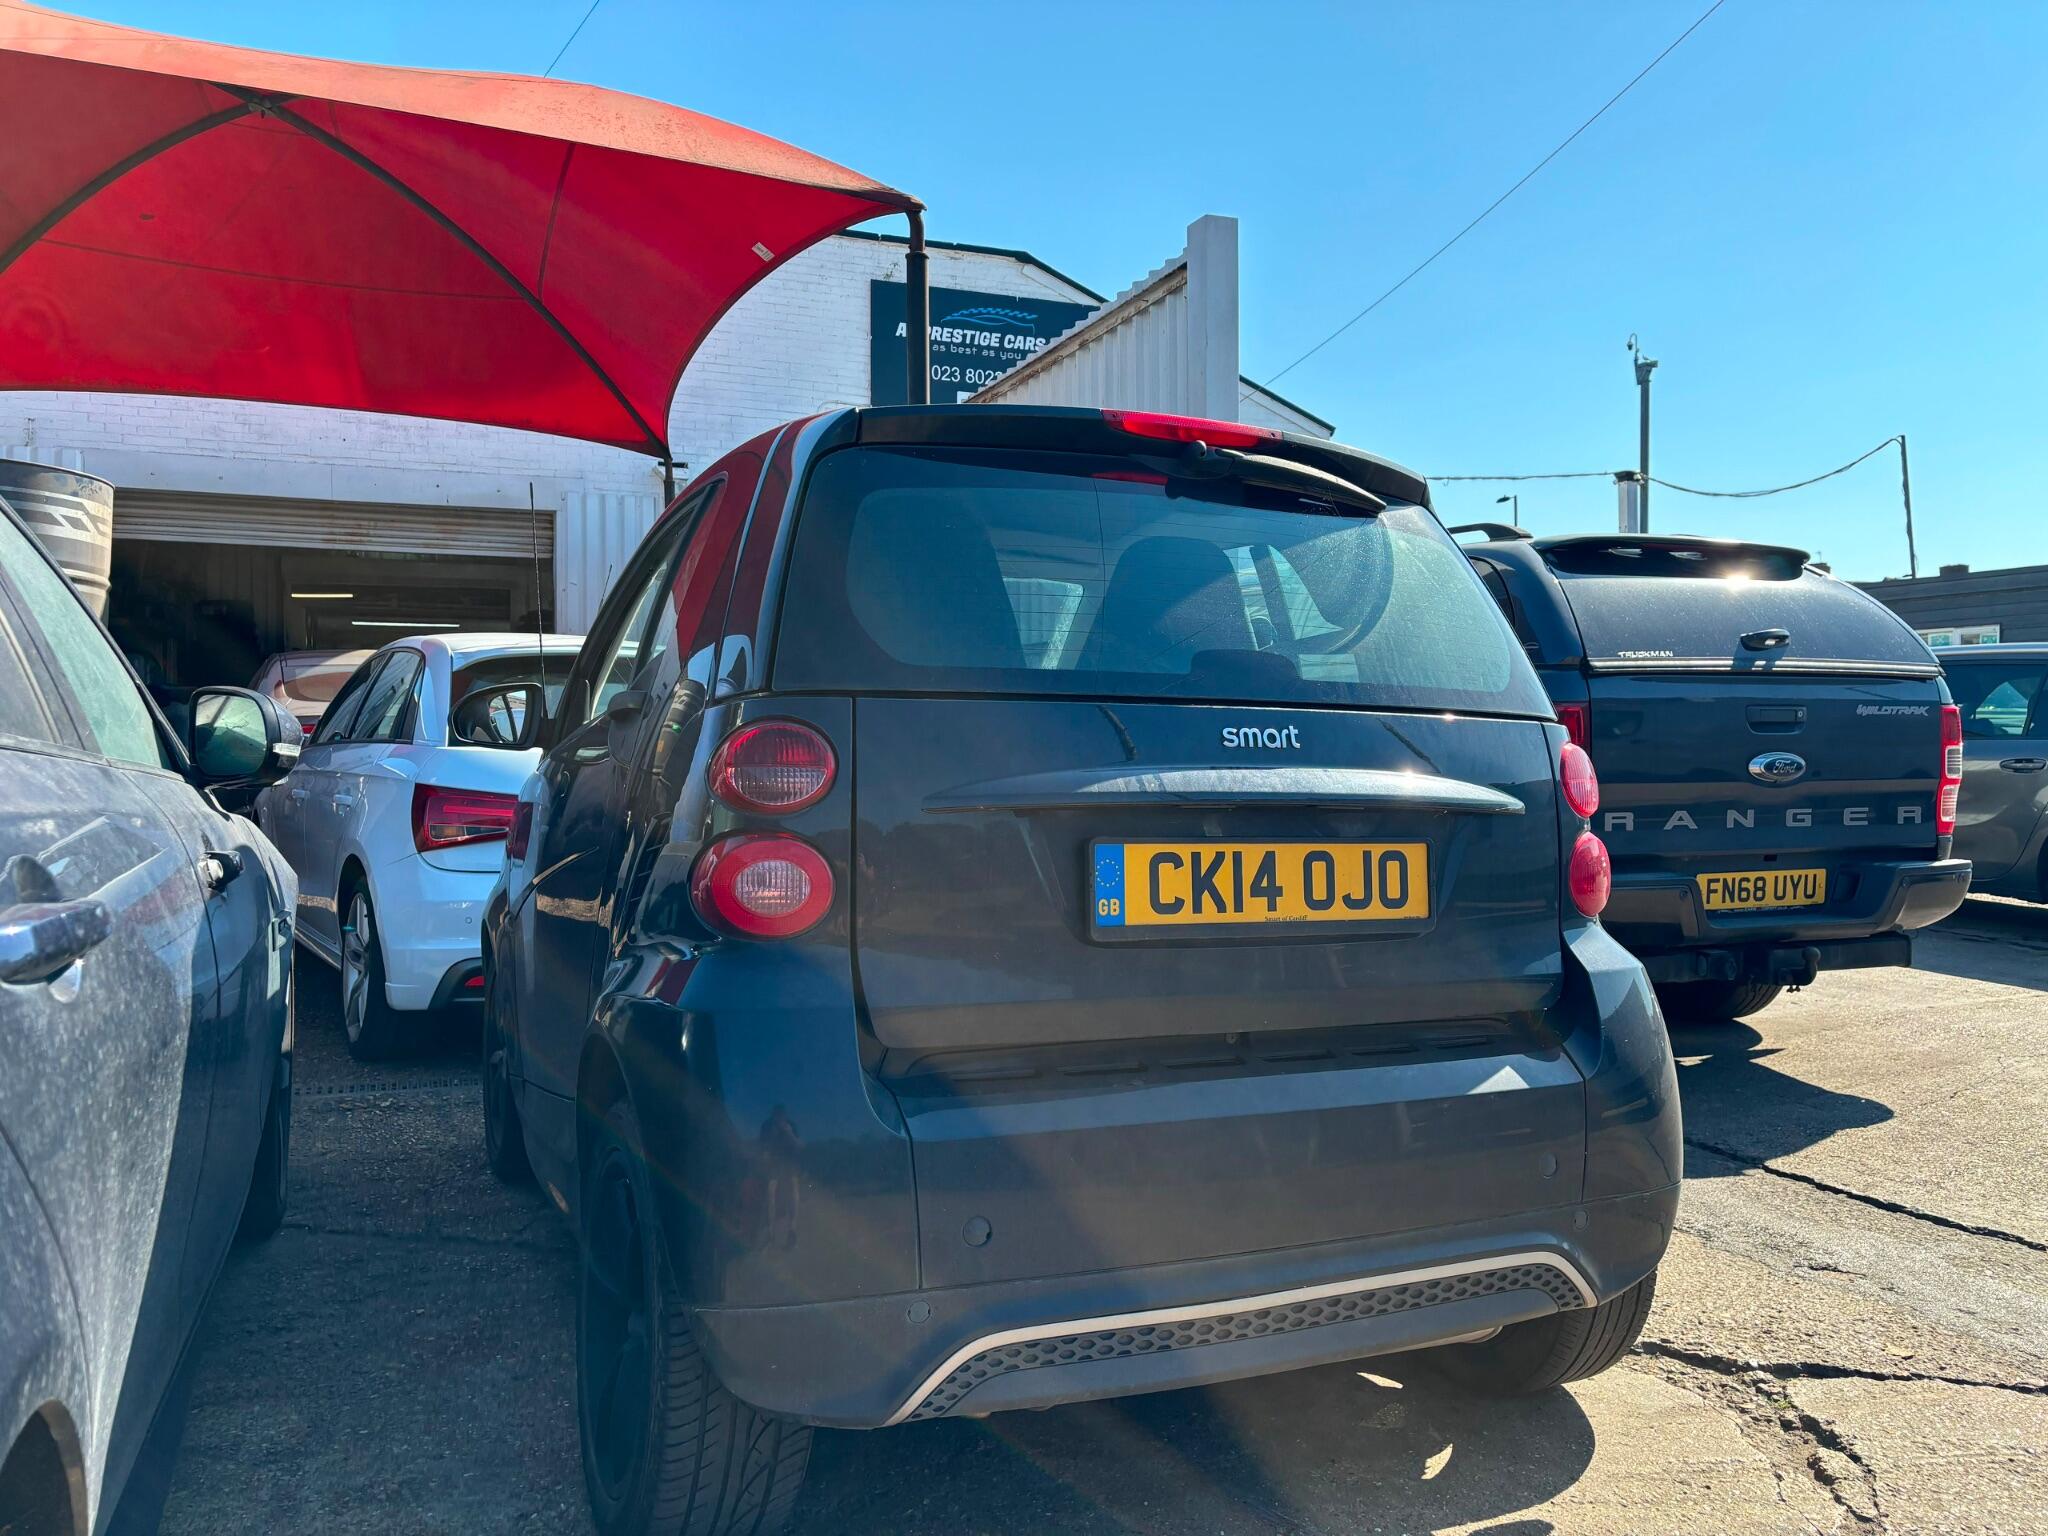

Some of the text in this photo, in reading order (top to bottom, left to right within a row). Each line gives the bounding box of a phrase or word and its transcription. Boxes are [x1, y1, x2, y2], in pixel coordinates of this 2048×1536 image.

[928, 326, 1001, 347] RESTIGE
[1003, 334, 1046, 352] CARS
[932, 344, 1022, 361] as best as you
[931, 365, 961, 382] 023
[1856, 704, 1930, 716] WILDTRAK
[1222, 725, 1301, 749] smart
[1773, 759, 1798, 774] Ford
[1604, 806, 1923, 832] RANGER
[1149, 850, 1409, 915] CK14 OJO
[1706, 874, 1817, 905] FN68 UYU
[1098, 898, 1120, 917] GB
